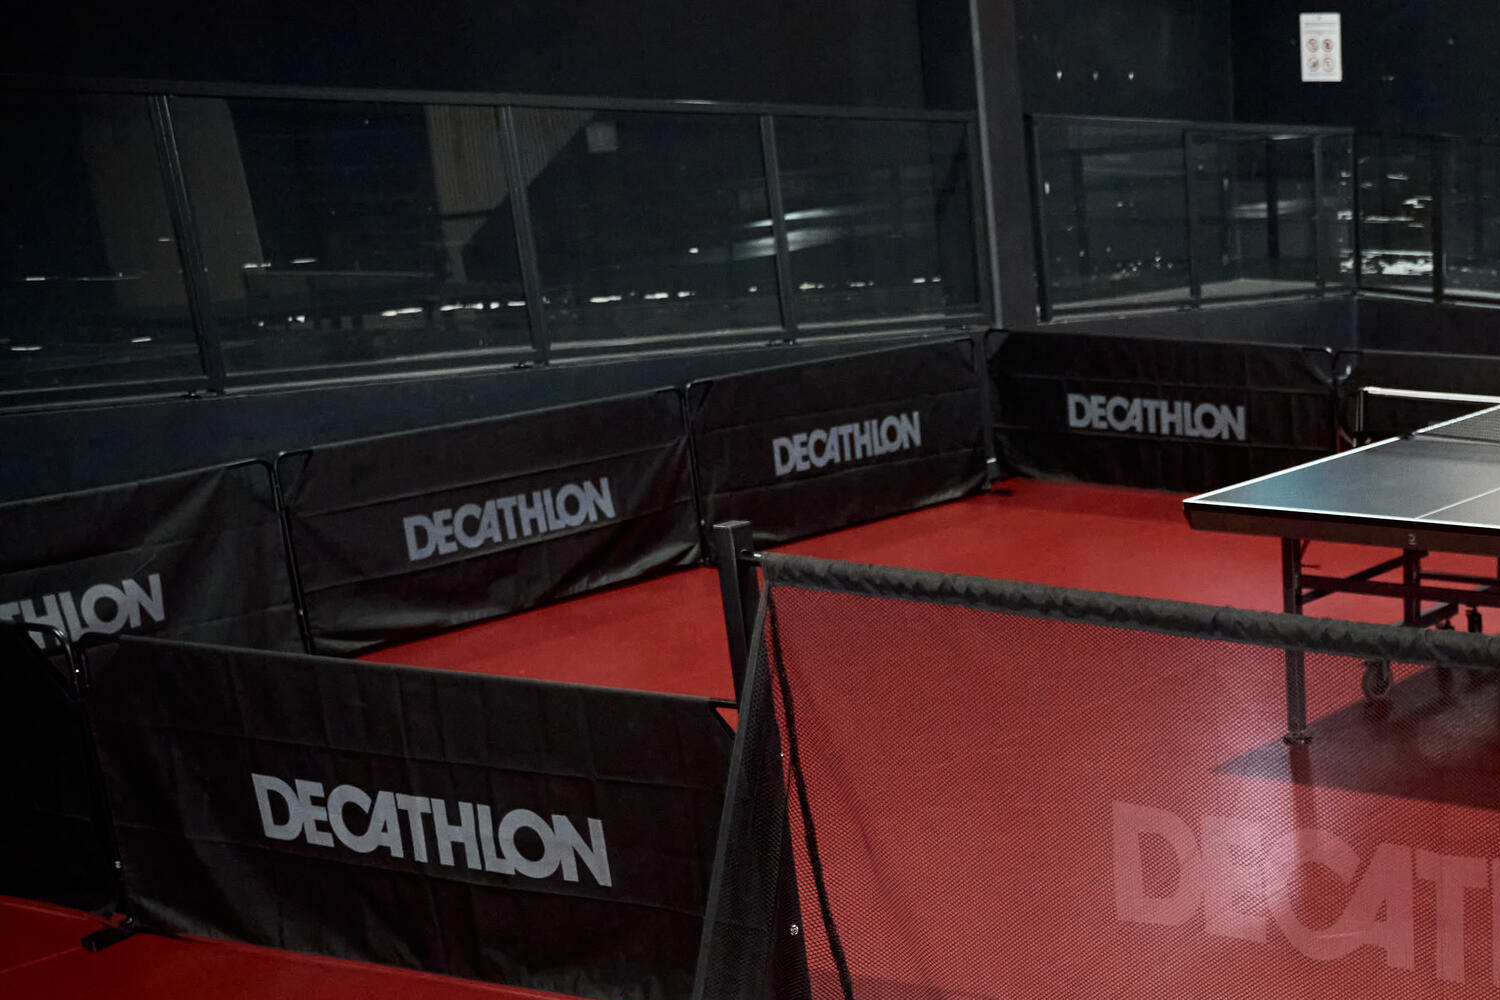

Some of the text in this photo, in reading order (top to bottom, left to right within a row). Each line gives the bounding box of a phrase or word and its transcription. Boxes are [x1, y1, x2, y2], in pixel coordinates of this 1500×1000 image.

[773, 411, 922, 477] DECATHLON
[1067, 393, 1246, 441] DECATHLON
[403, 477, 616, 562] DECATHLON
[251, 773, 612, 887] DECATHLON
